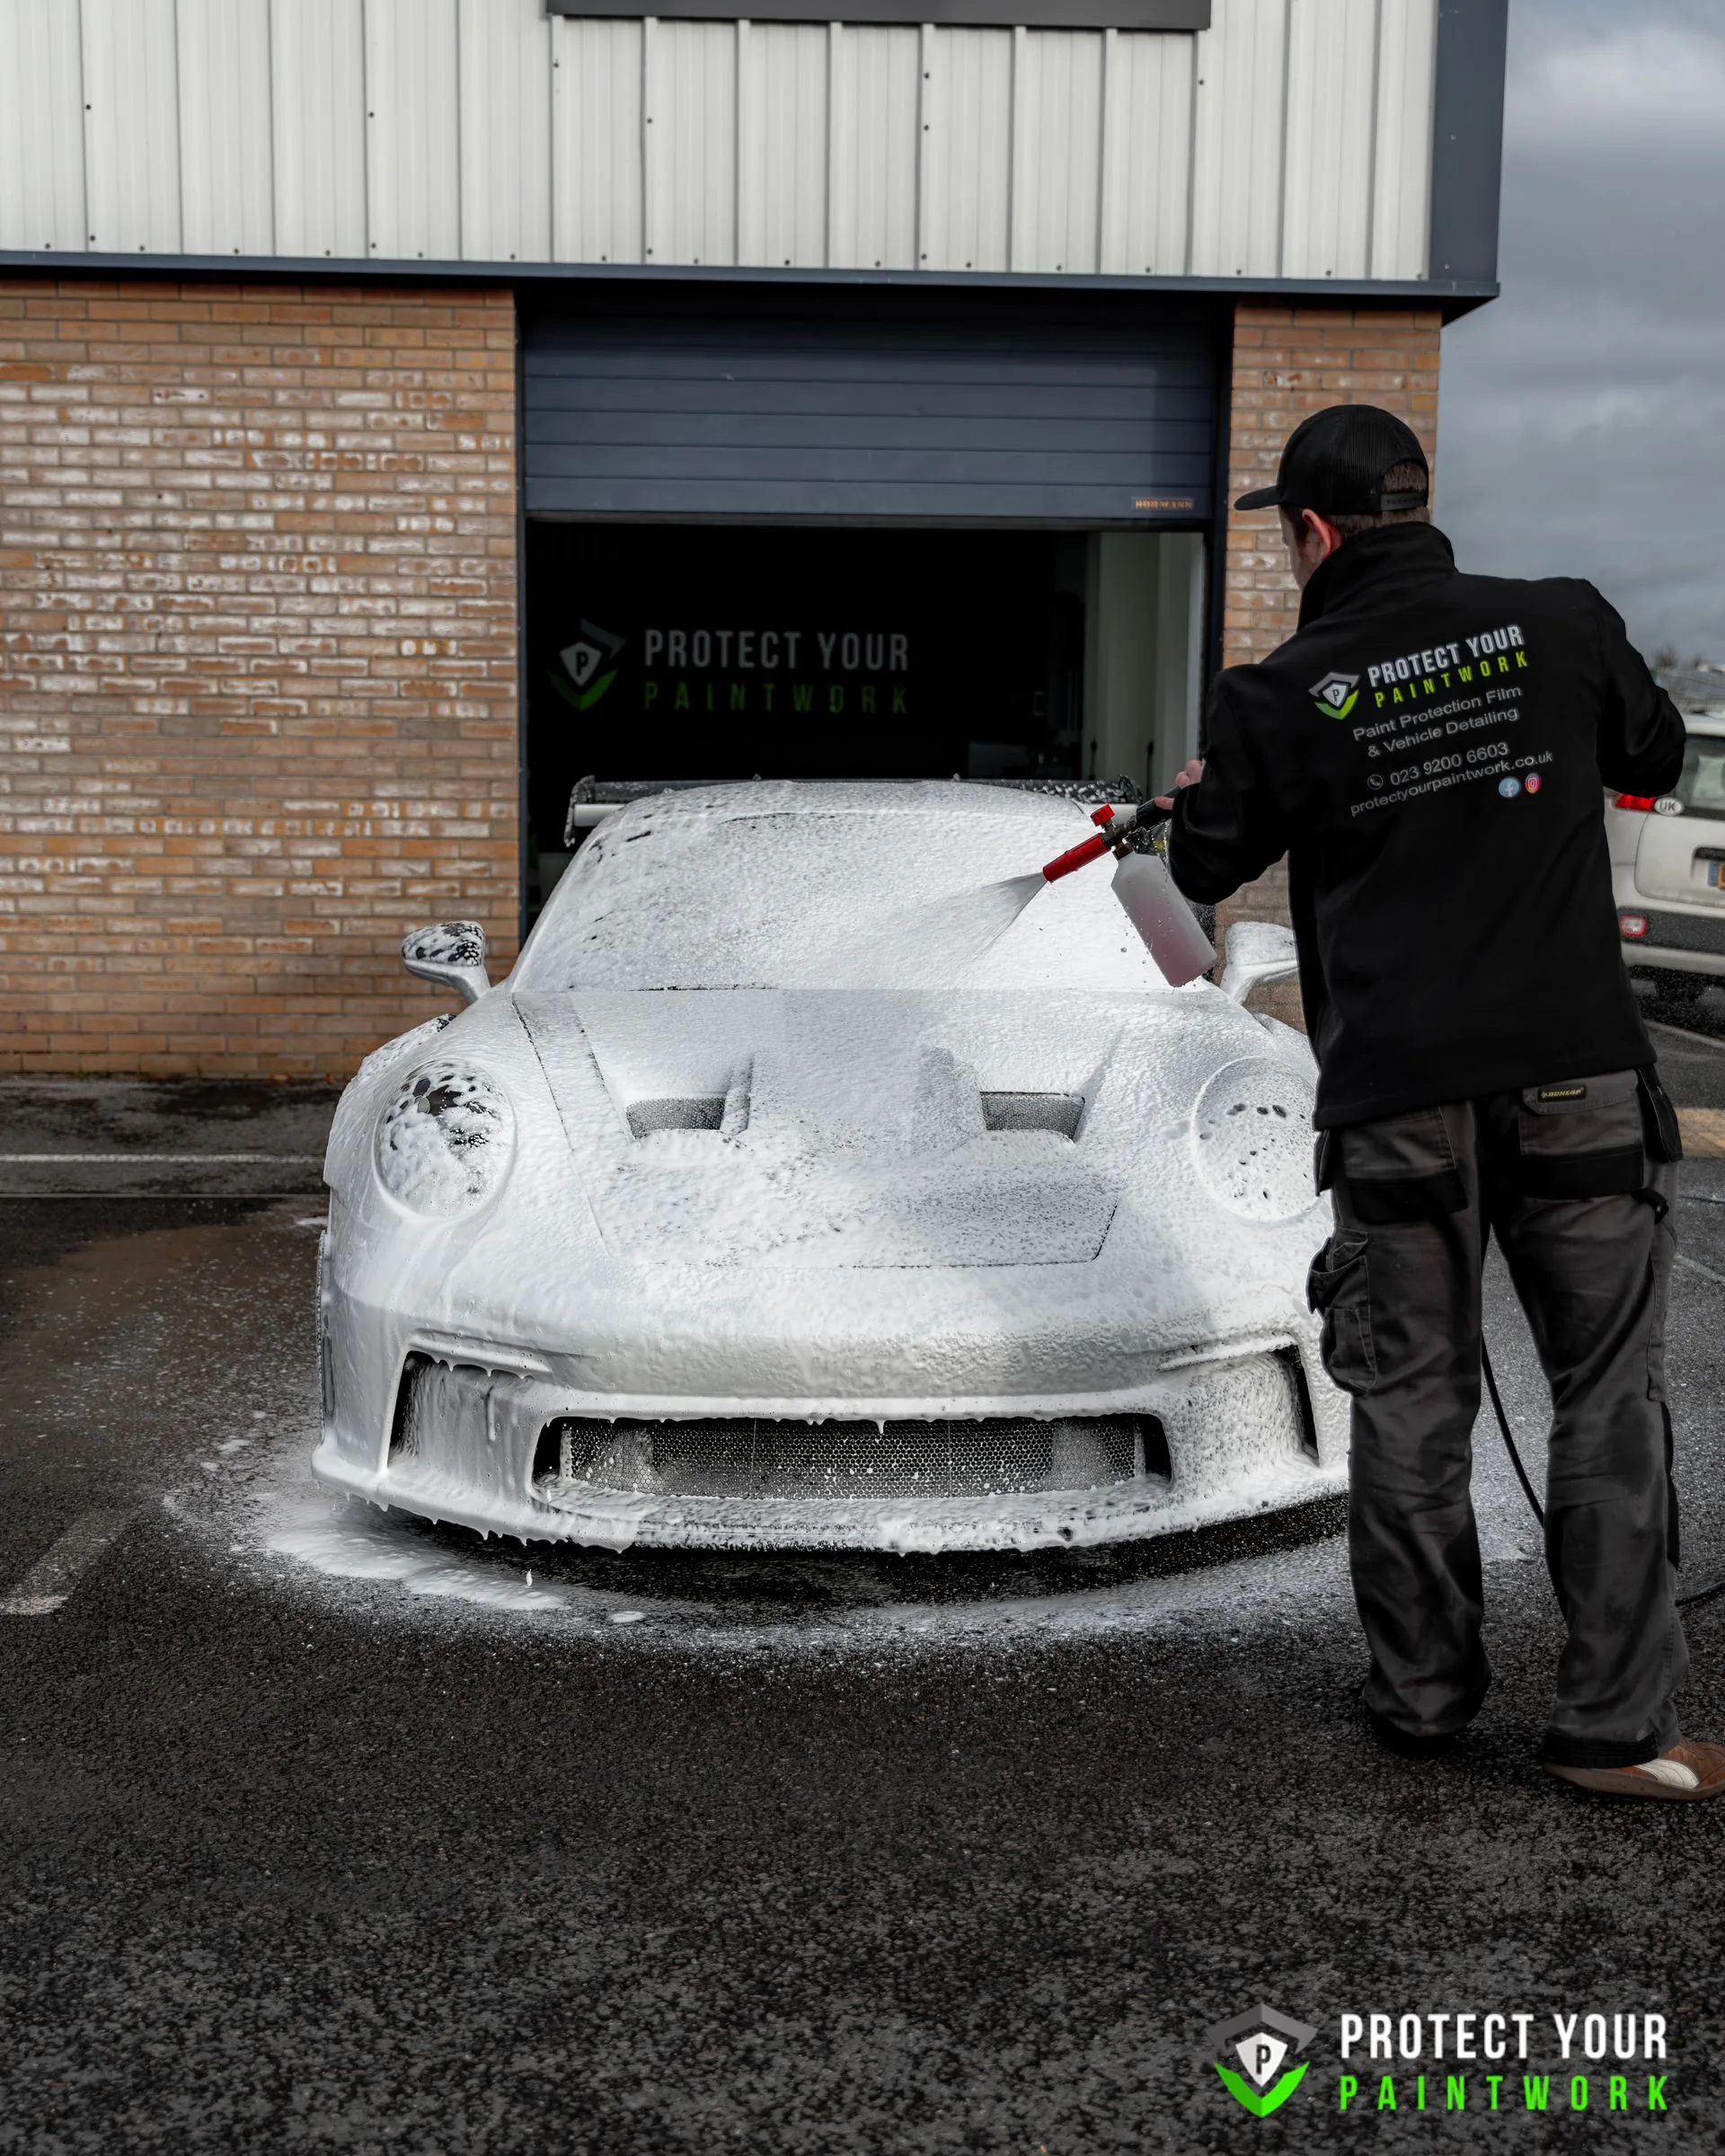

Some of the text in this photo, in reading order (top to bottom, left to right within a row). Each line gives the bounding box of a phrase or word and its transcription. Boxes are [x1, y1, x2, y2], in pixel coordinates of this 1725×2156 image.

[644, 629, 908, 671] PROTECT YOUR
[1367, 624, 1526, 687] PROTECT YOUR
[644, 681, 908, 714] PAINTWORK
[1374, 650, 1528, 708] PAINTWORK
[1352, 686, 1522, 740] Paint Protection Film
[1367, 706, 1519, 758] & Vehicle Detailing
[1349, 750, 1552, 817] protectyourpaintwork.co.uk
[1389, 741, 1509, 786] 023 9200 6603
